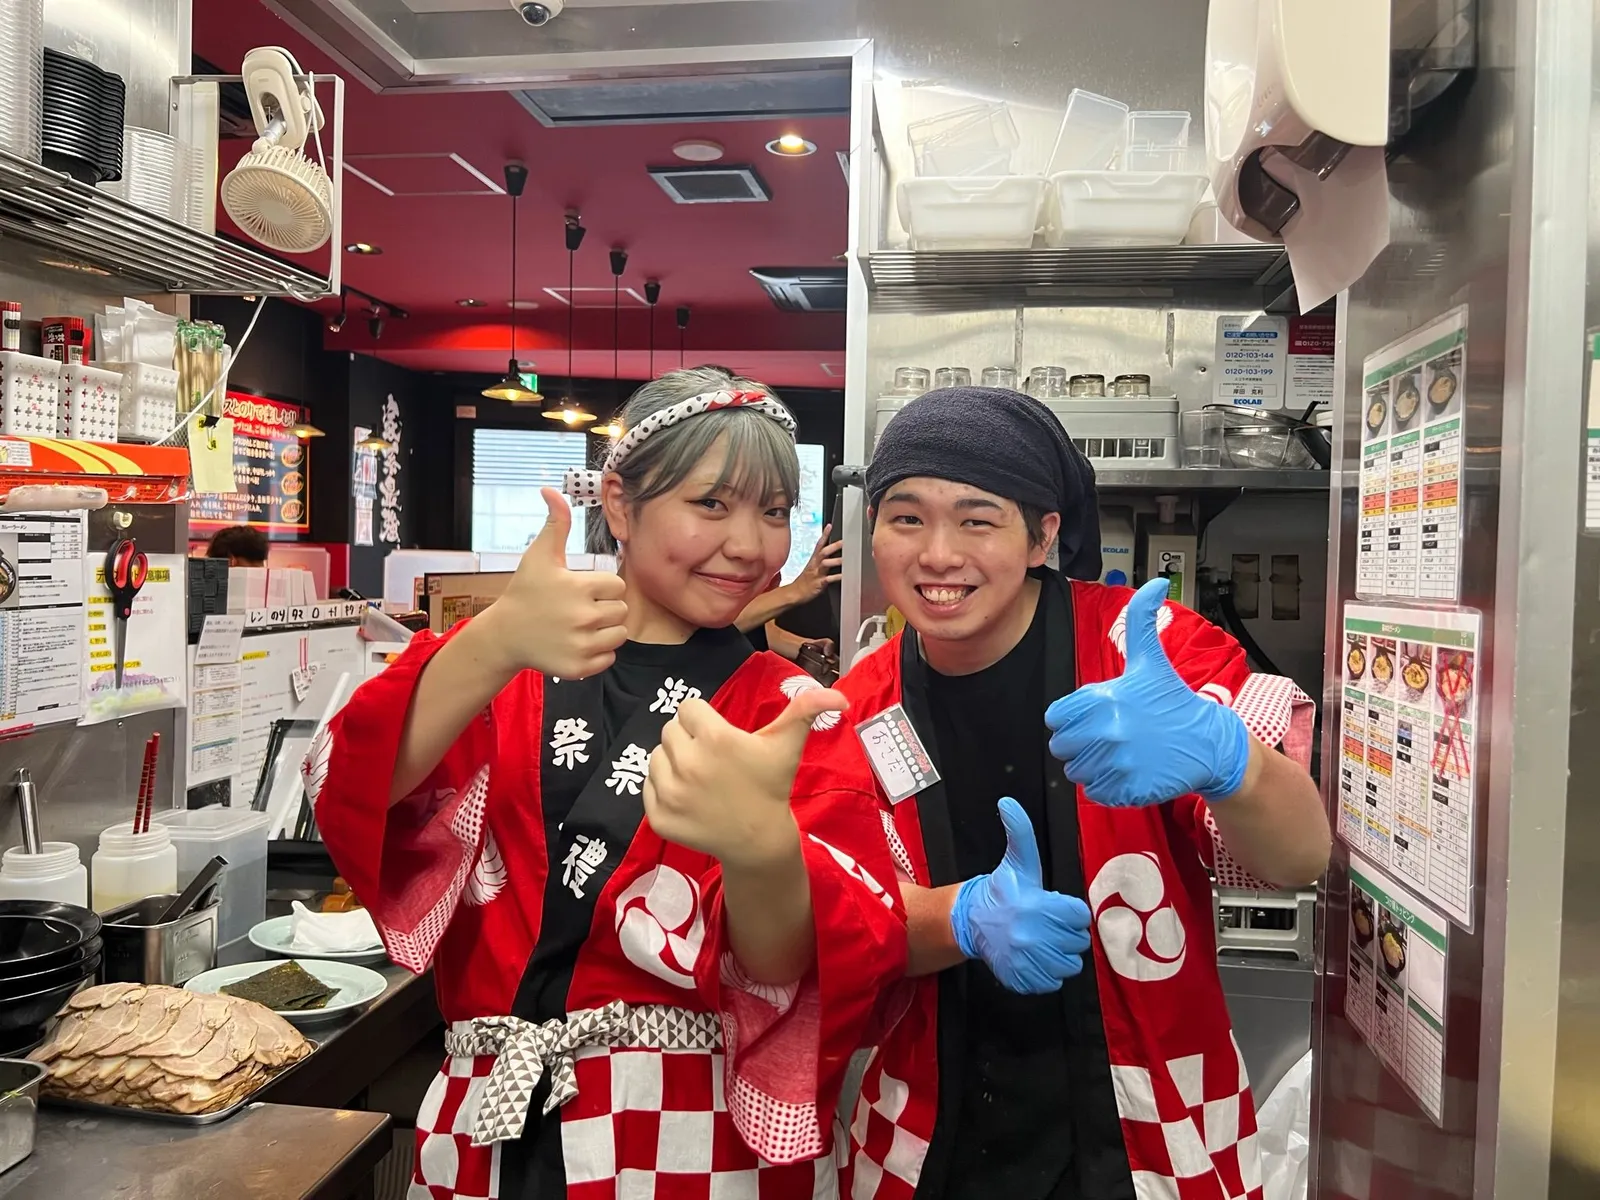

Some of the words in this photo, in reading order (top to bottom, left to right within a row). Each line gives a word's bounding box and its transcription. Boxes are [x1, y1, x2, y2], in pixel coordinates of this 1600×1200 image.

[250, 611, 264, 623] レン
[270, 609, 285, 620] のり
[872, 730, 906, 774] おさだ
